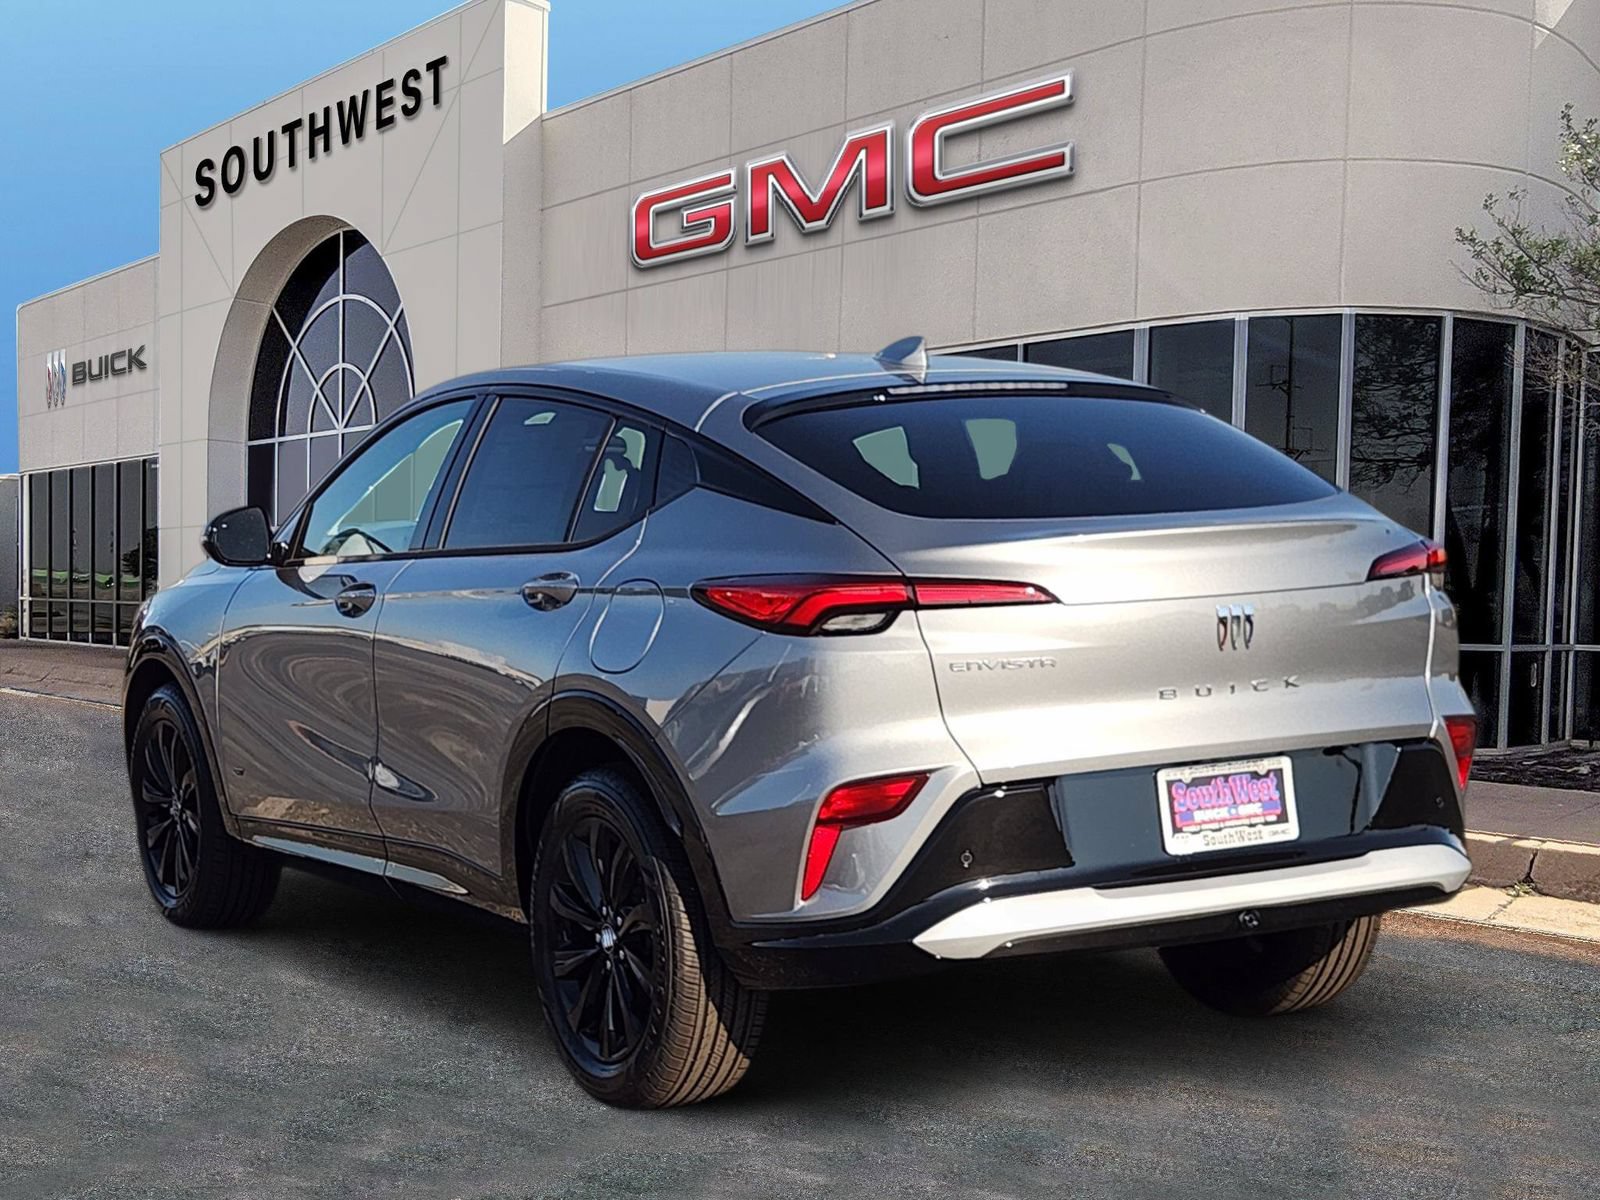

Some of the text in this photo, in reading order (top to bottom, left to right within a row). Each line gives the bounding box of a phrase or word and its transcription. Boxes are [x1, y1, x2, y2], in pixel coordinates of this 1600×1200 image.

[194, 56, 448, 208] SOUTHWEST
[630, 68, 1075, 269] GMC
[71, 343, 147, 386] BUICK
[949, 657, 1057, 673] ENVISTA
[1158, 675, 1302, 701] BUICK
